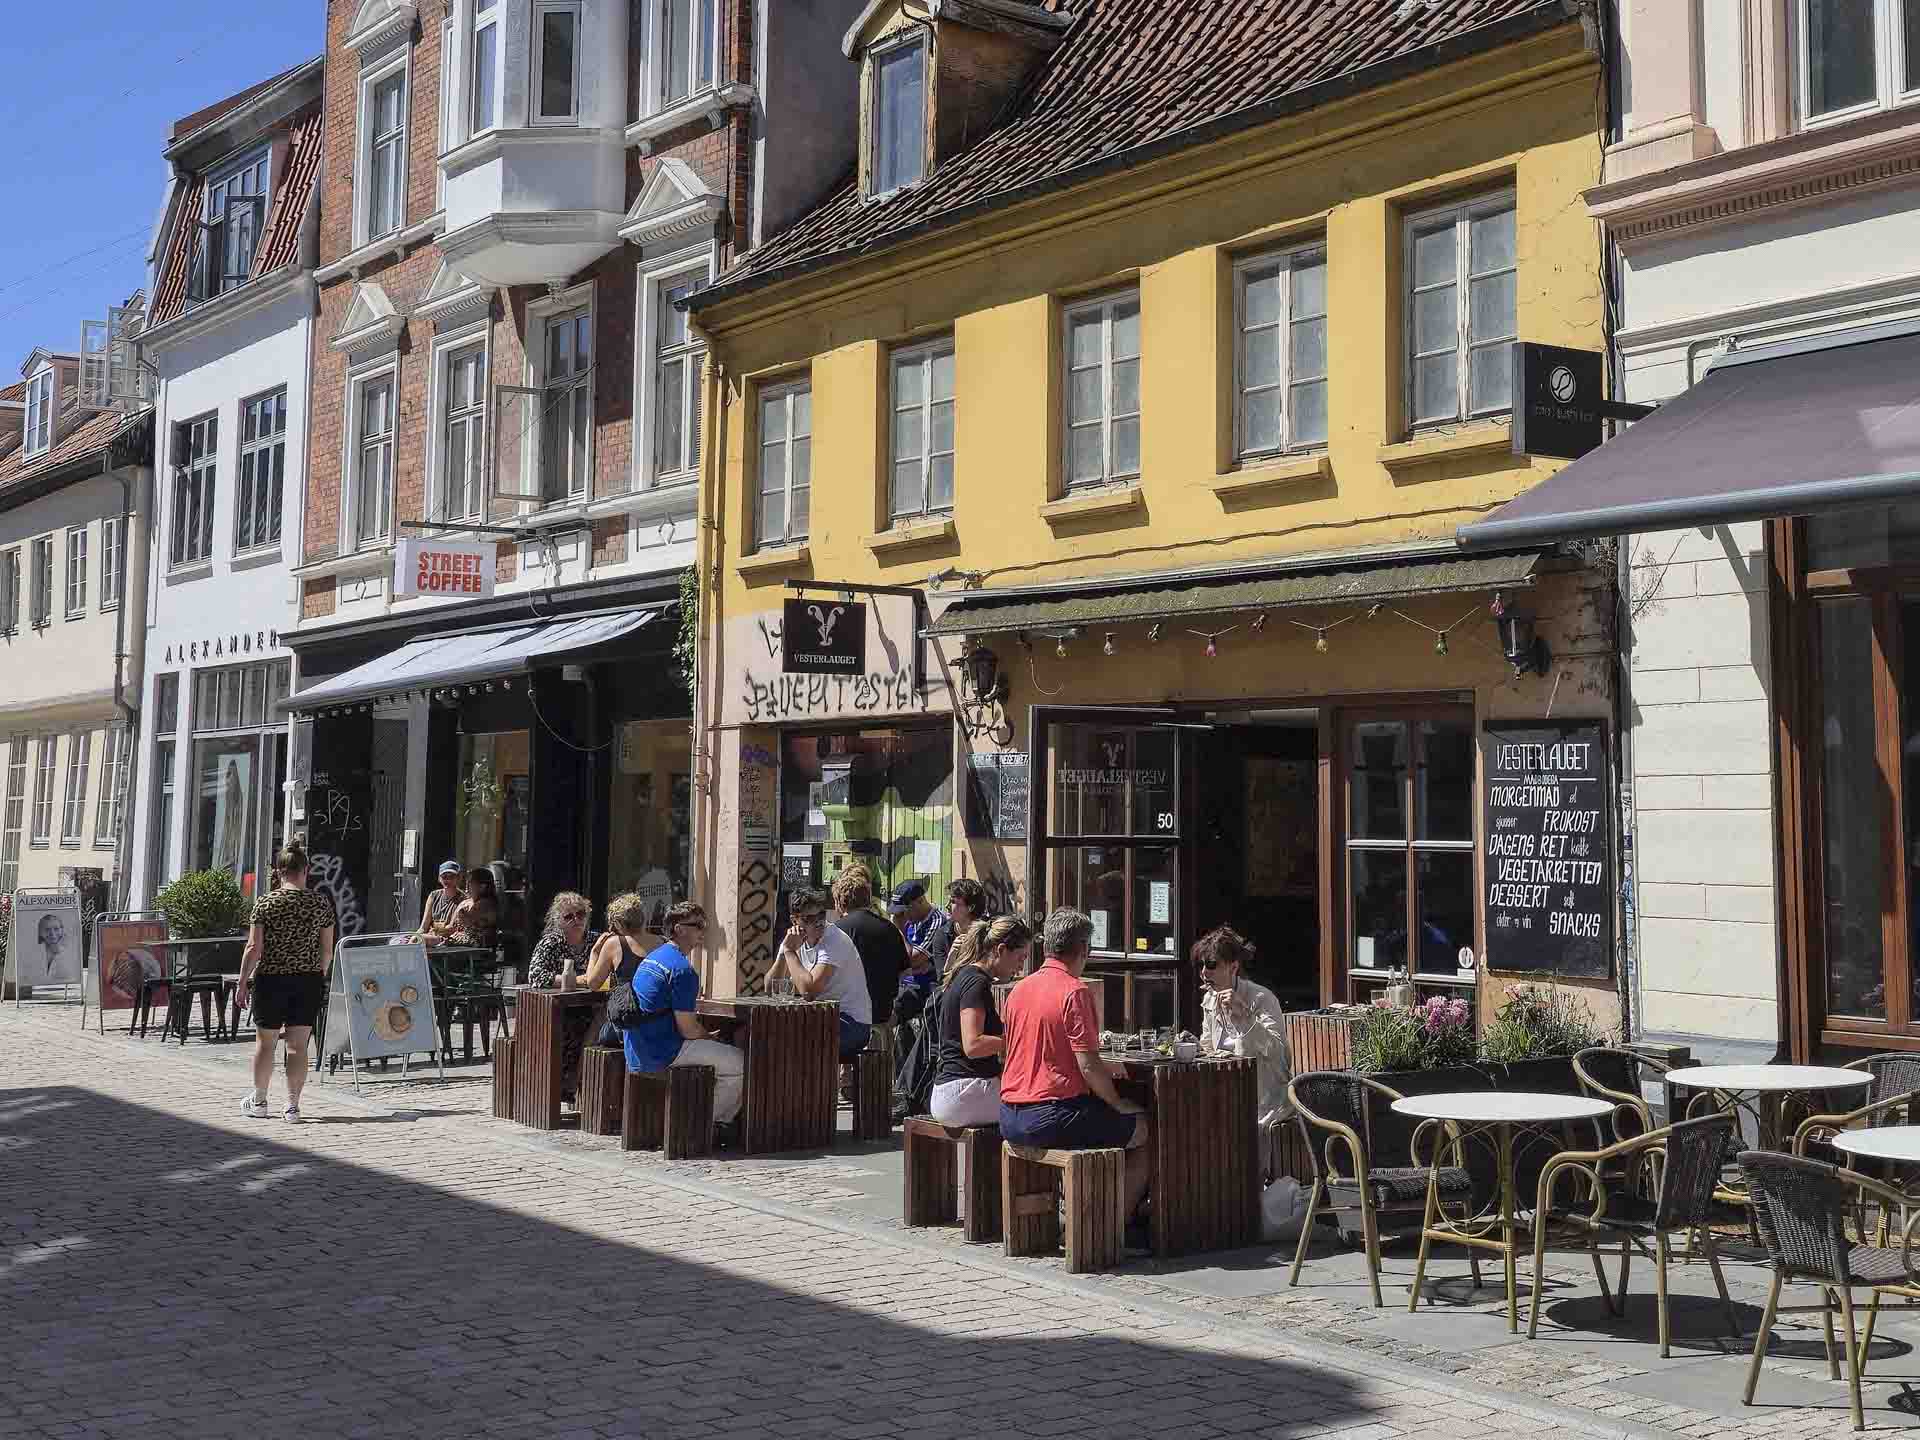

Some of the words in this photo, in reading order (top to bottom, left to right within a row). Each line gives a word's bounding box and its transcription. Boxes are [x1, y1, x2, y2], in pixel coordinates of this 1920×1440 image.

[418, 551, 480, 572] STREET
[416, 571, 481, 592] COFFEE
[165, 628, 277, 664] ALEXANDER
[794, 653, 857, 665] VESTERLAUGET
[1496, 743, 1591, 770] VESTERLAUGET
[1489, 785, 1560, 808] MORGENMAD
[1157, 812, 1173, 830] 50
[1543, 810, 1600, 833] FROKOST
[1488, 834, 1535, 857] DAGENS
[1539, 834, 1569, 858] RET
[1498, 858, 1602, 885] VEGETARRETTEN
[18, 895, 77, 906] ALEXANDER
[1489, 883, 1551, 909] DESSERT
[1549, 911, 1601, 937] SNACKS
